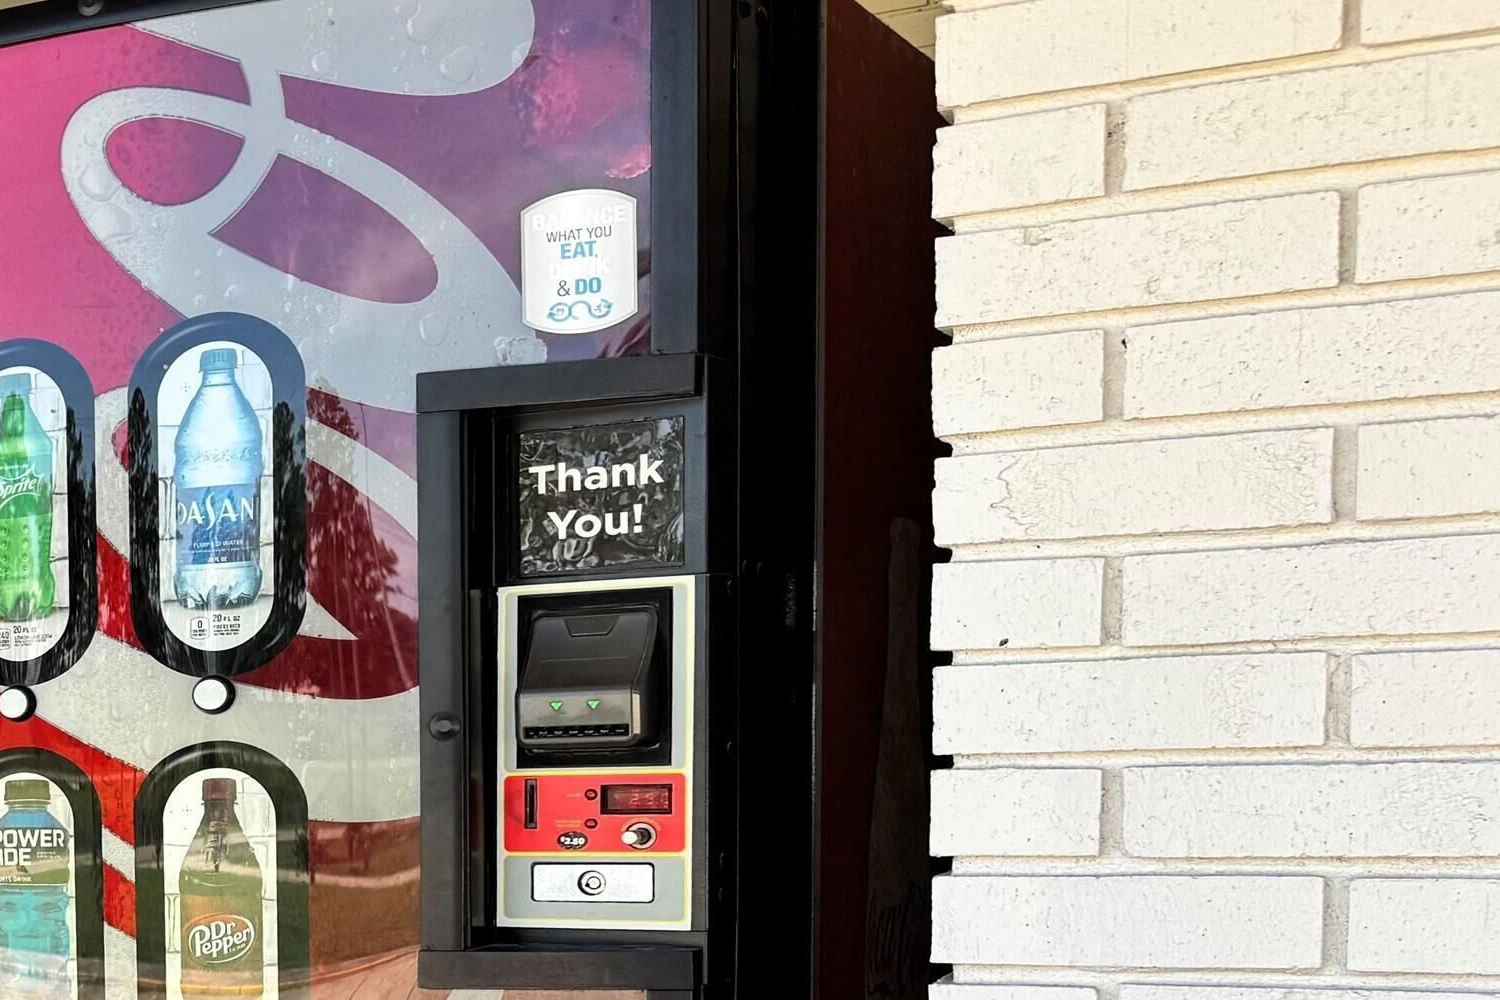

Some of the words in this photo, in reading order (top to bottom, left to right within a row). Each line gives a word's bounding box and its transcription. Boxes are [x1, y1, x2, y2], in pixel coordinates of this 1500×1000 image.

[546, 228, 583, 243] WHAT
[586, 225, 613, 238] YOU
[557, 280, 571, 297] &
[575, 277, 602, 295] DO
[529, 453, 664, 495] Thank
[547, 503, 644, 540] You!
[13, 625, 22, 634] 20
[194, 924, 251, 958] Pepper
[210, 920, 236, 941] Dr
